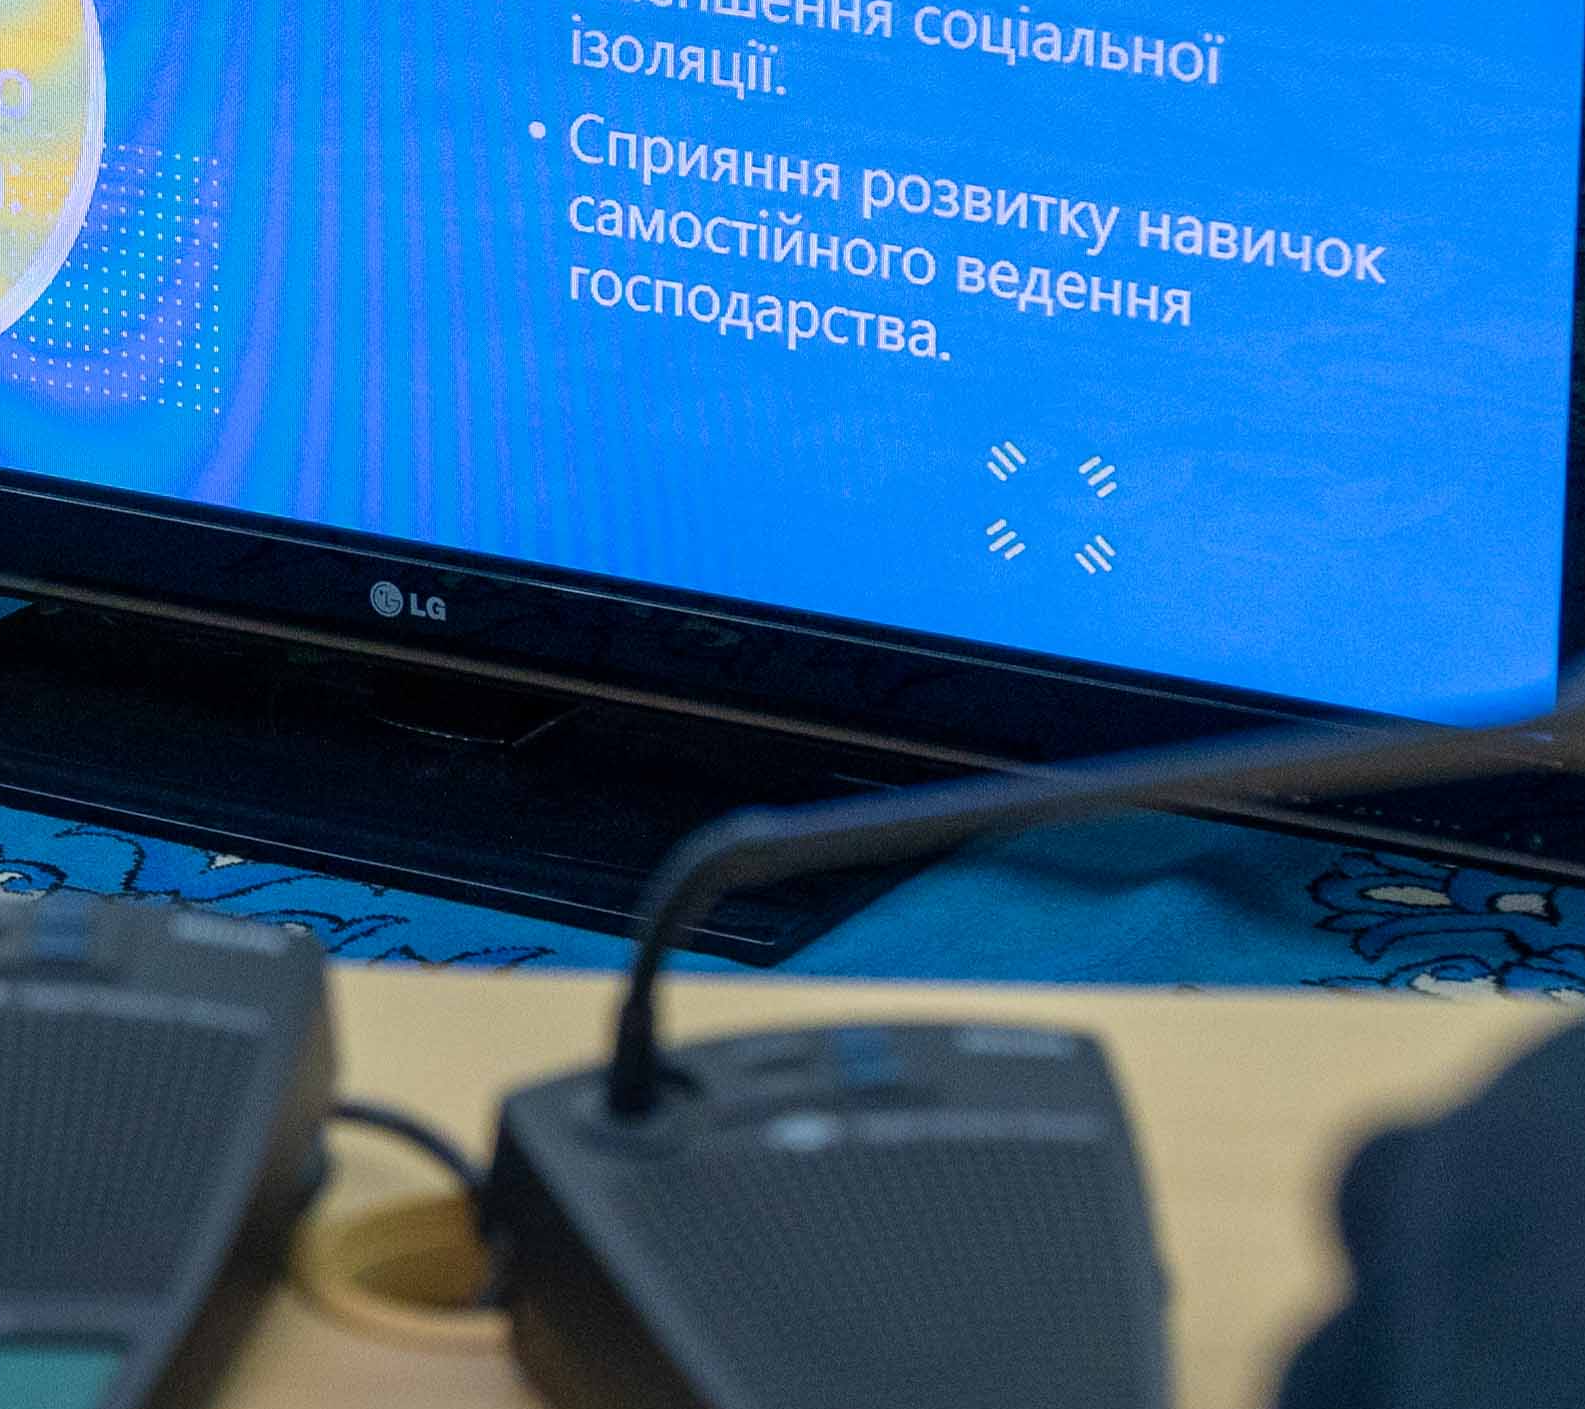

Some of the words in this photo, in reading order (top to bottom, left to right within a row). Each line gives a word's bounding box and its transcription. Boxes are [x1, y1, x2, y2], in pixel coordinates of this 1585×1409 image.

[570, 14, 788, 100] ізоляції.
[913, 4, 1225, 84] соціальної
[569, 112, 841, 201] Сприяння
[863, 167, 1120, 257] розвитку
[1138, 209, 1387, 284] навичок
[569, 194, 937, 286] самостійного
[956, 254, 1192, 326] ведення
[570, 265, 952, 361] господарства.
[409, 593, 447, 622] LG
